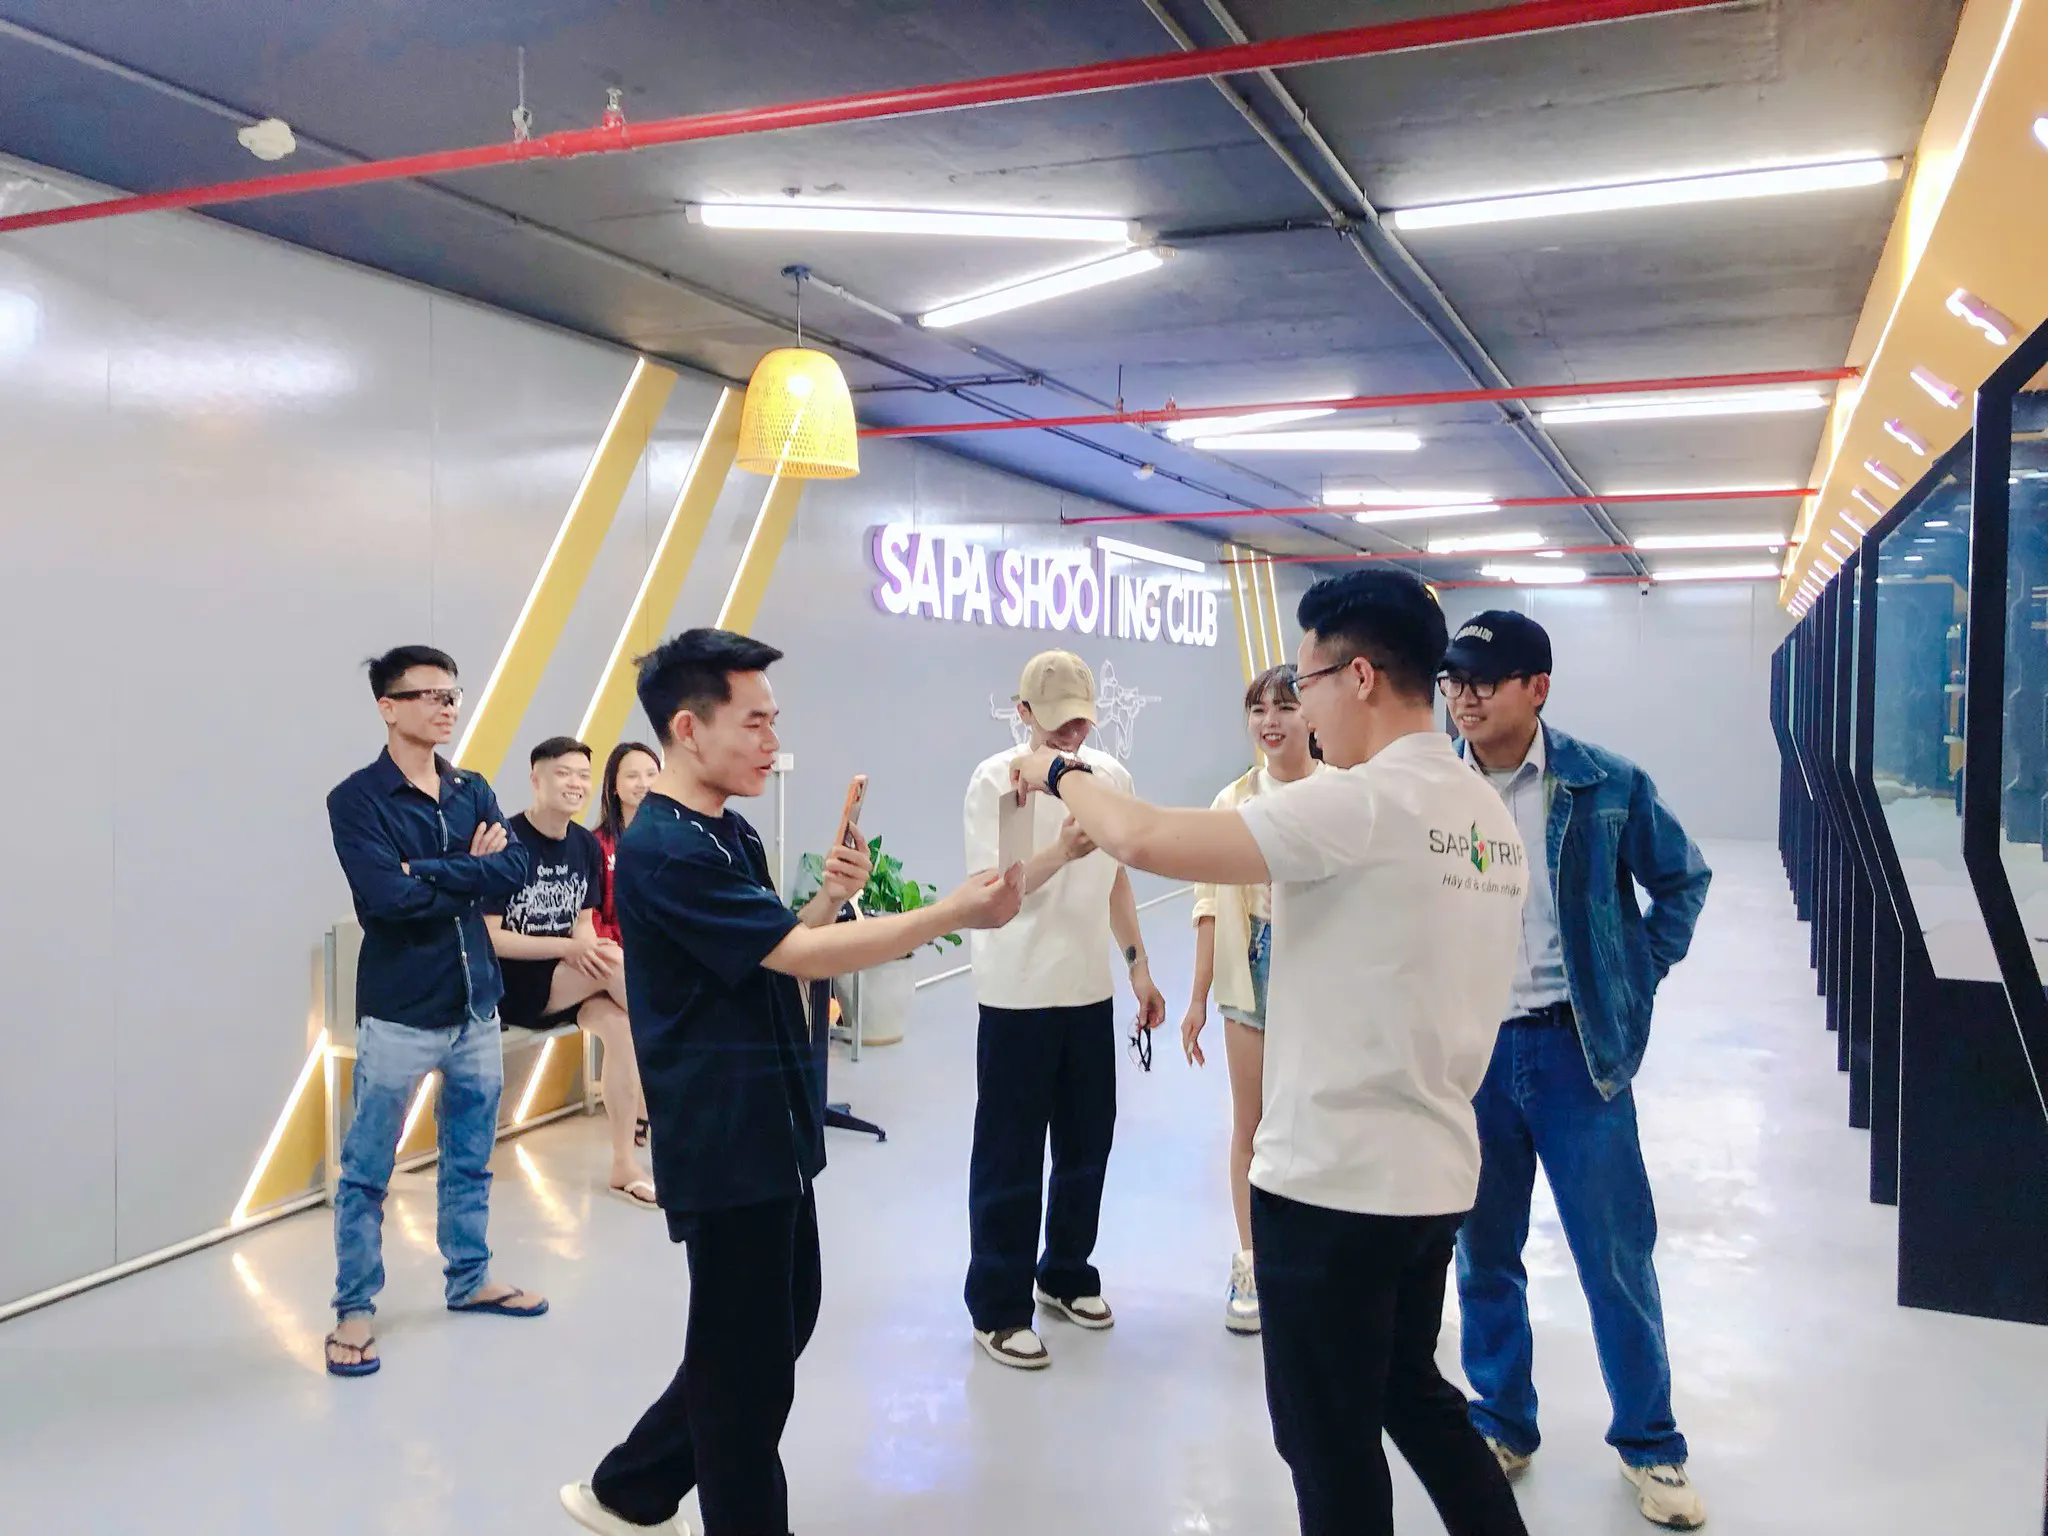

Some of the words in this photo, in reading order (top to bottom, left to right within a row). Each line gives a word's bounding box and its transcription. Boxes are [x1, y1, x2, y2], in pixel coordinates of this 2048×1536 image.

[876, 523, 992, 625] SAPA
[998, 535, 1205, 641] SHOOTING
[1167, 583, 1218, 647] CLUB
